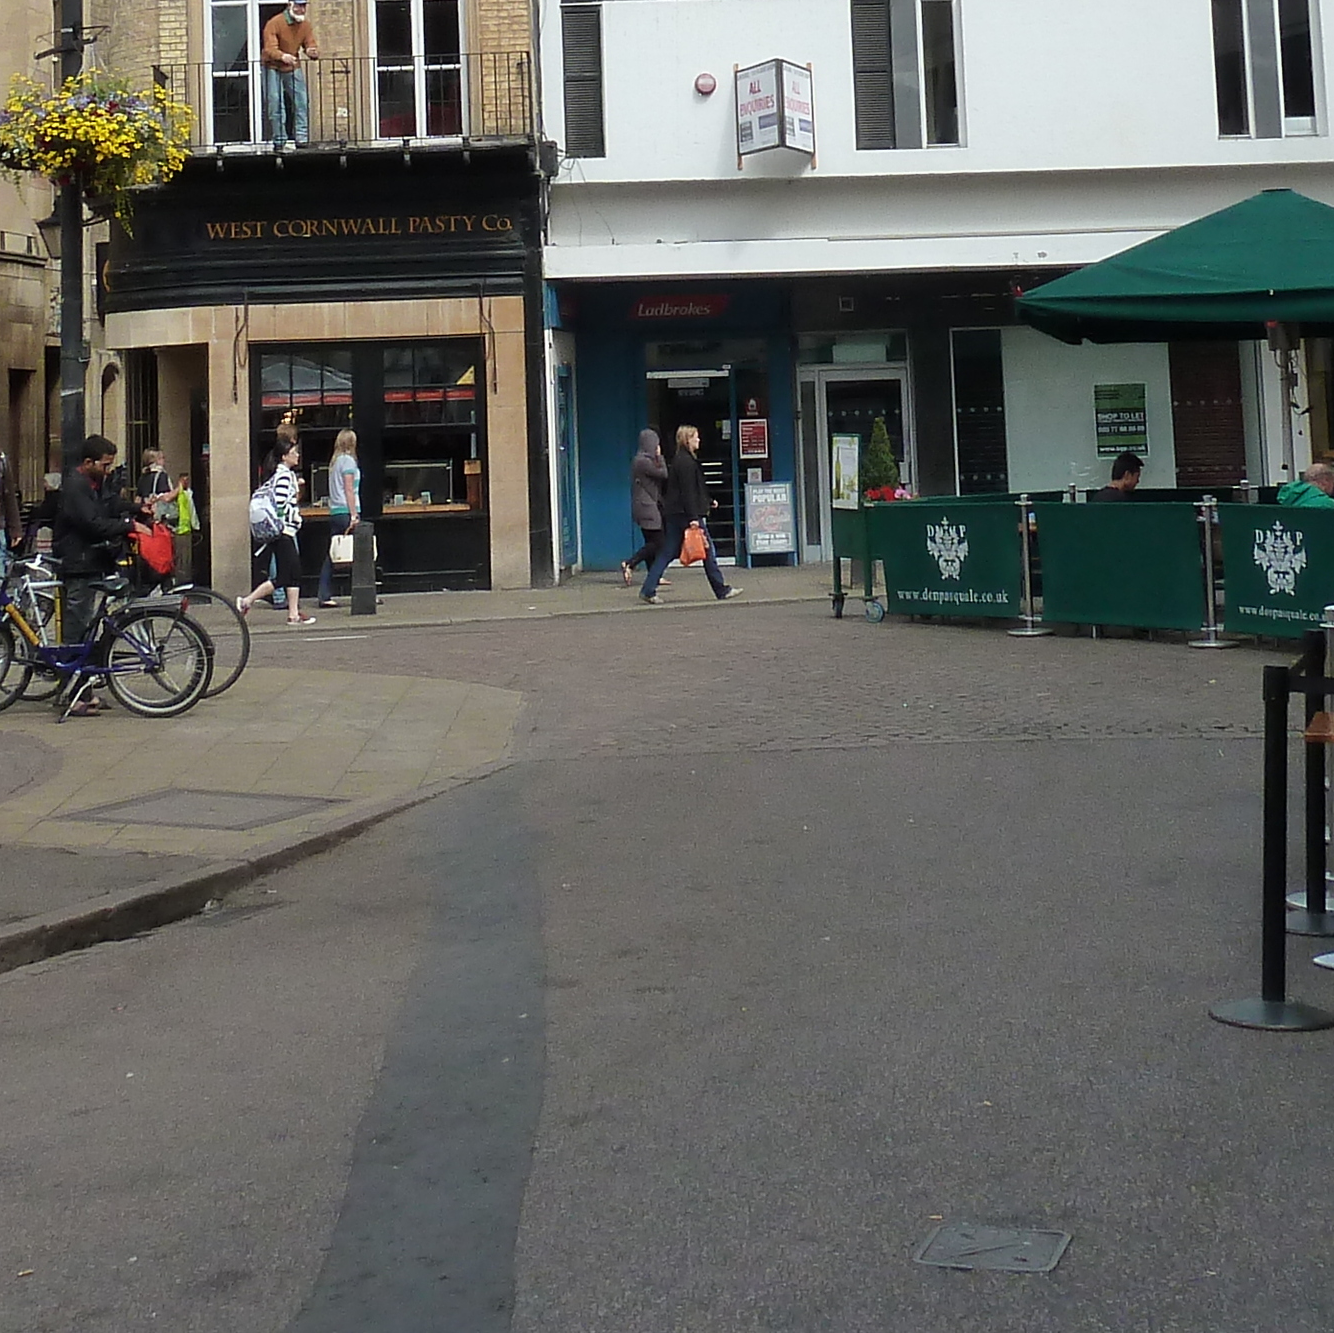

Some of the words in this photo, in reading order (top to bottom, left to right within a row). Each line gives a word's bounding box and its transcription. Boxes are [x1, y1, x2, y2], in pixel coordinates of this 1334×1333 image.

[206, 221, 267, 240] WEST
[273, 217, 402, 239] CORNWALL
[408, 215, 477, 234] PASTY
[637, 302, 711, 317] Ladbrokes
[1097, 412, 1118, 420] SHOP
[1131, 411, 1144, 419] LET
